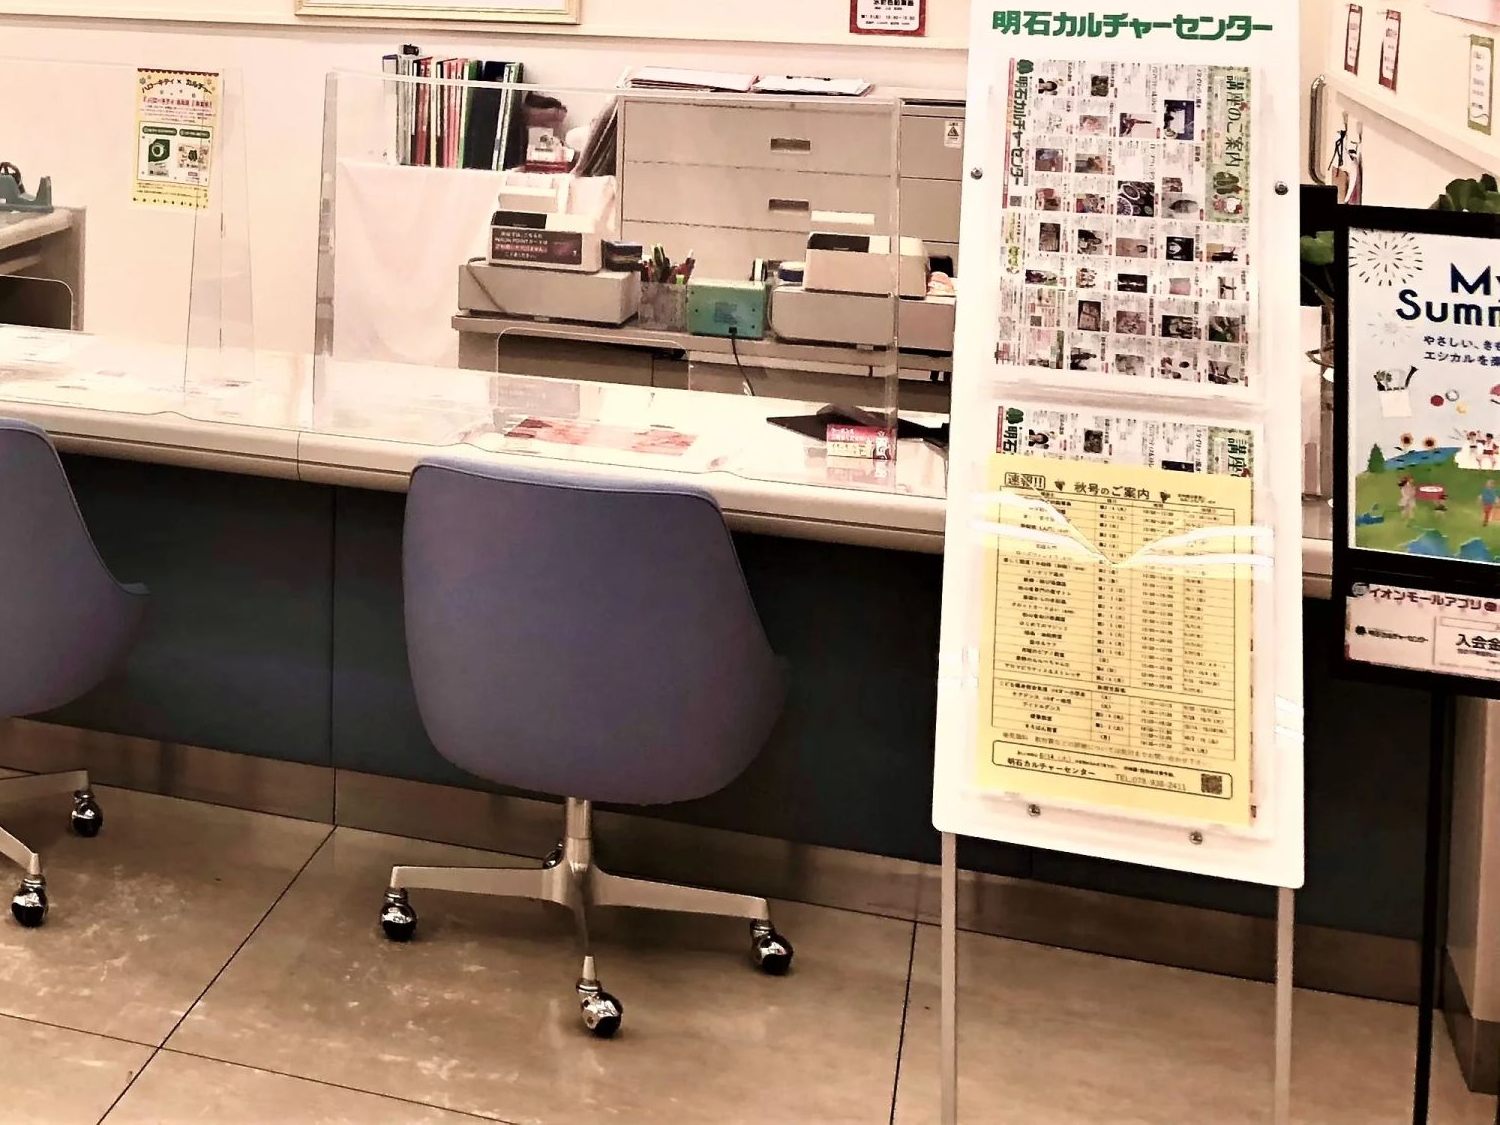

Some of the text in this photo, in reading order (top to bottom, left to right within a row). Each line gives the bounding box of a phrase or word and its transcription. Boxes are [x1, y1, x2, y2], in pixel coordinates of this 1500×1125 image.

[992, 10, 1273, 42] 明石カルチャーセンター
[1010, 76, 1028, 185] 明石カルチャーセンター
[1225, 75, 1245, 167] 講座のご案内
[1003, 425, 1018, 454] 明石
[1227, 437, 1249, 478] 講座
[1074, 481, 1150, 500] 秋号のご案内
[1369, 588, 1482, 610] イオンモールアプリ
[1007, 757, 1096, 776] 明石カルチャーセンター
